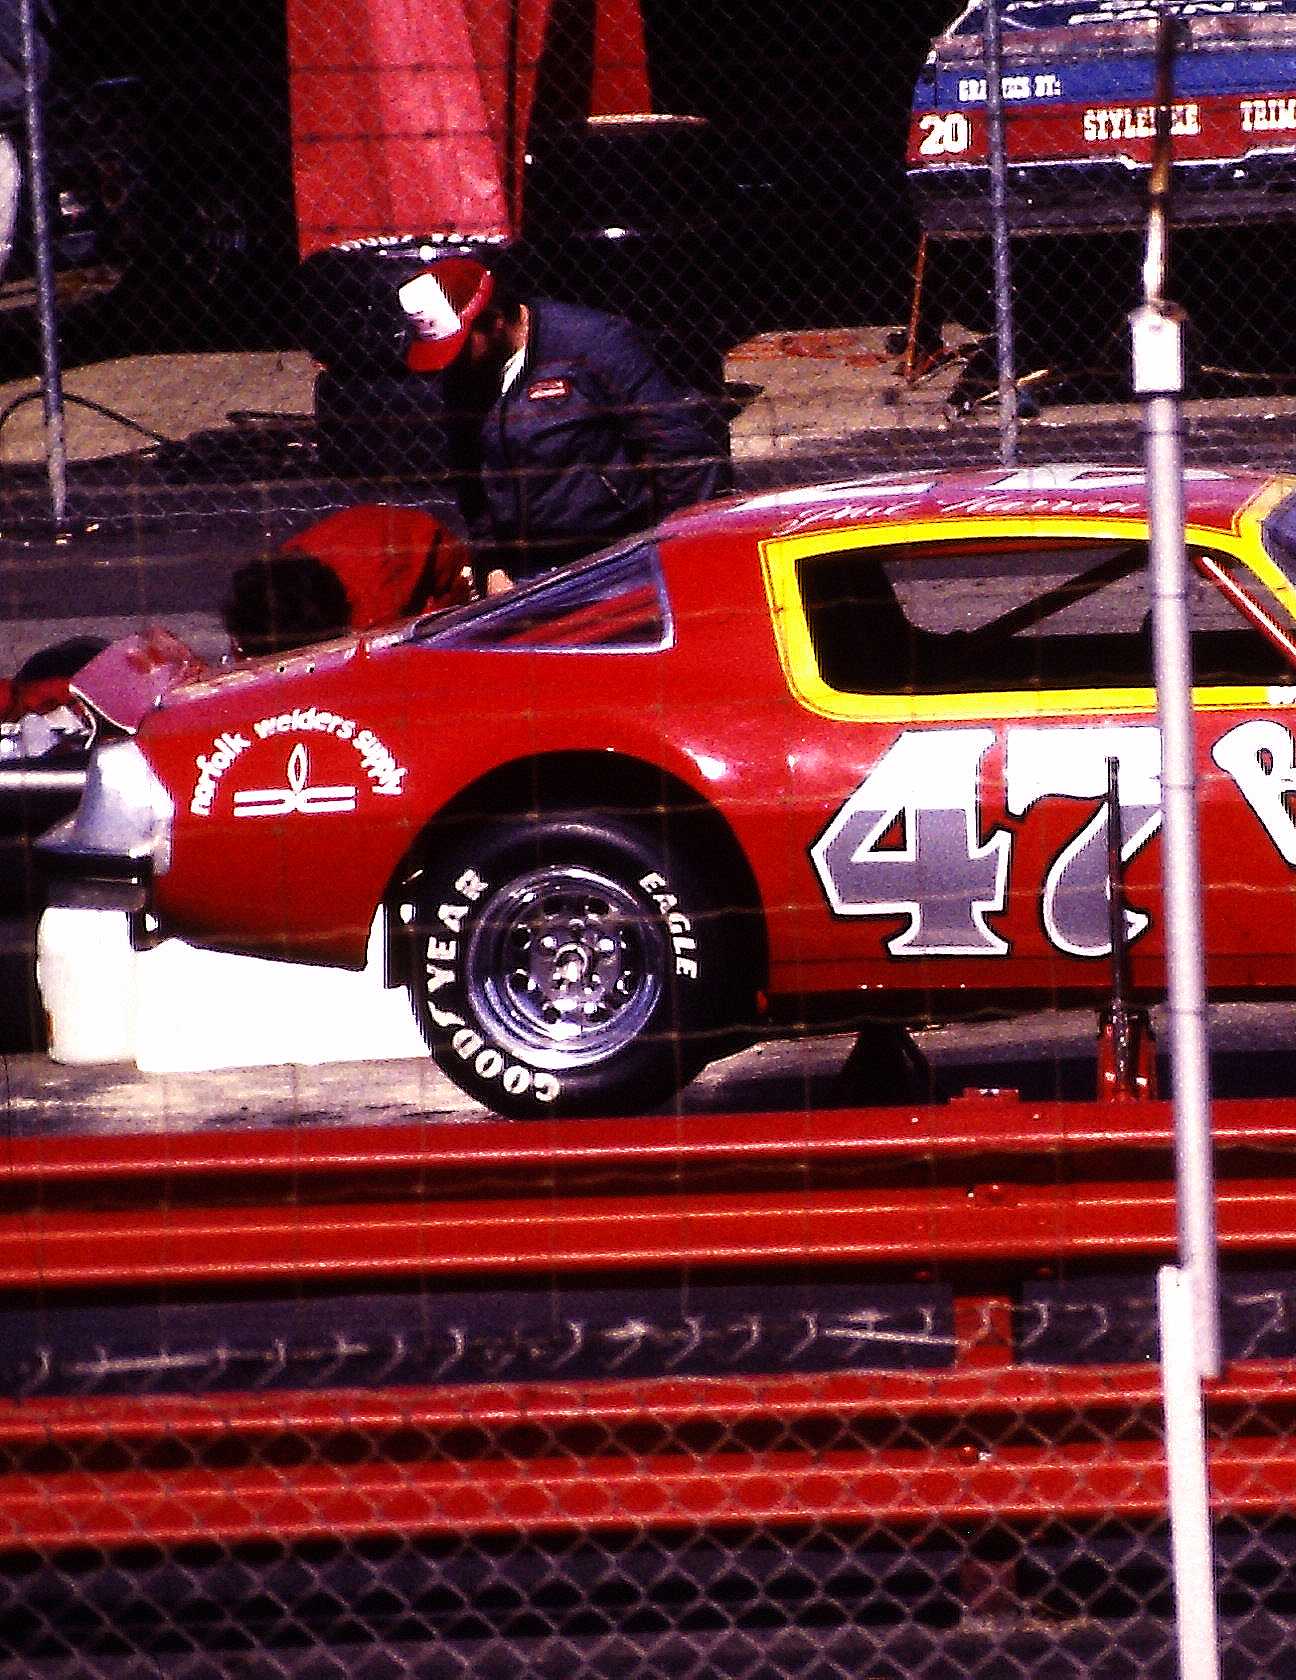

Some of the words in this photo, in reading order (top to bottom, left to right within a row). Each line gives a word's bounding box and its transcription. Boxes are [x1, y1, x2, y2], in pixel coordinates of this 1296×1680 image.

[919, 112, 970, 155] 20
[253, 707, 356, 740] welders
[811, 727, 1162, 958] 47
[639, 872, 699, 979] EAGLE
